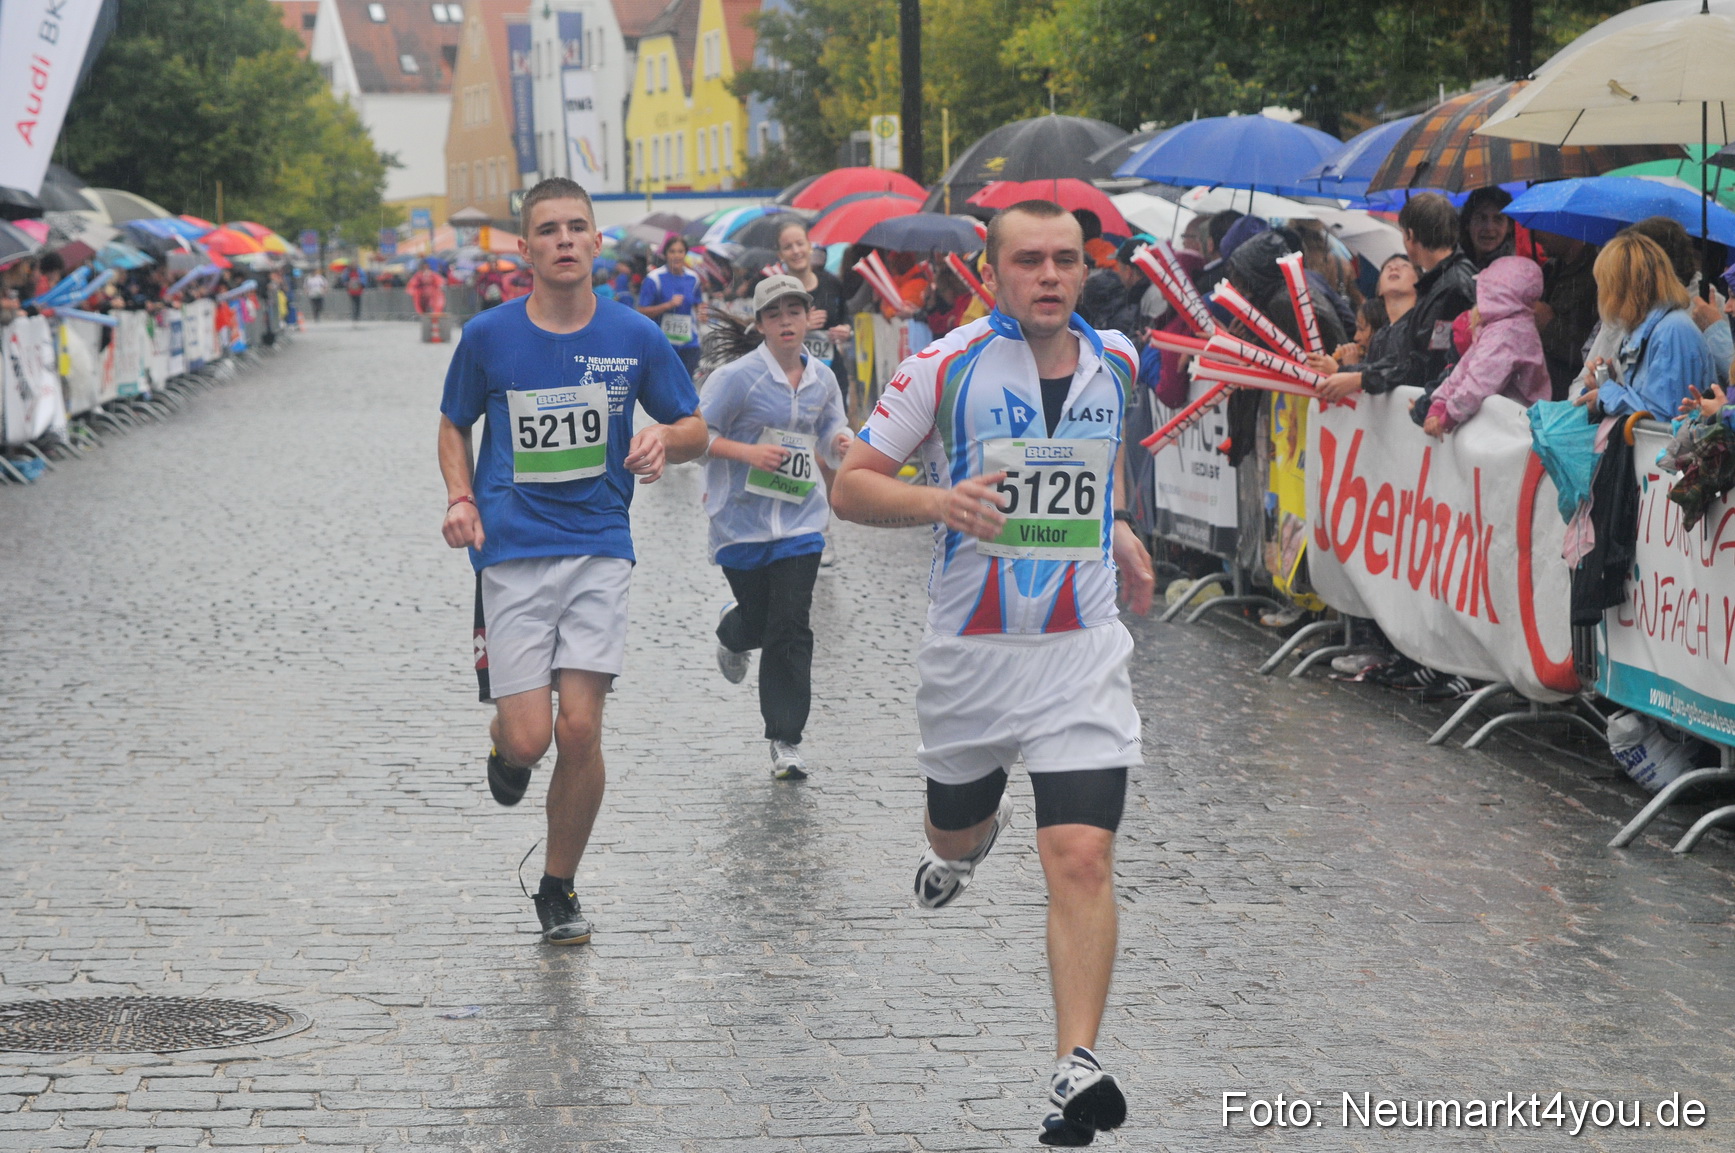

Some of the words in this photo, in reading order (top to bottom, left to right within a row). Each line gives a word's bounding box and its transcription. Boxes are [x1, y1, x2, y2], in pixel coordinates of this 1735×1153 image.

[16, 53, 52, 147] Audi
[573, 355, 587, 364] 12.
[588, 356, 638, 366] NEUMARKTER
[586, 363, 629, 373] STADTLAUF
[536, 392, 577, 405] BOCK
[518, 409, 601, 449] 5219
[1025, 446, 1074, 459] BOCK
[769, 475, 799, 494] Anja
[996, 470, 1096, 516] 5126
[1020, 524, 1068, 543] Viktor
